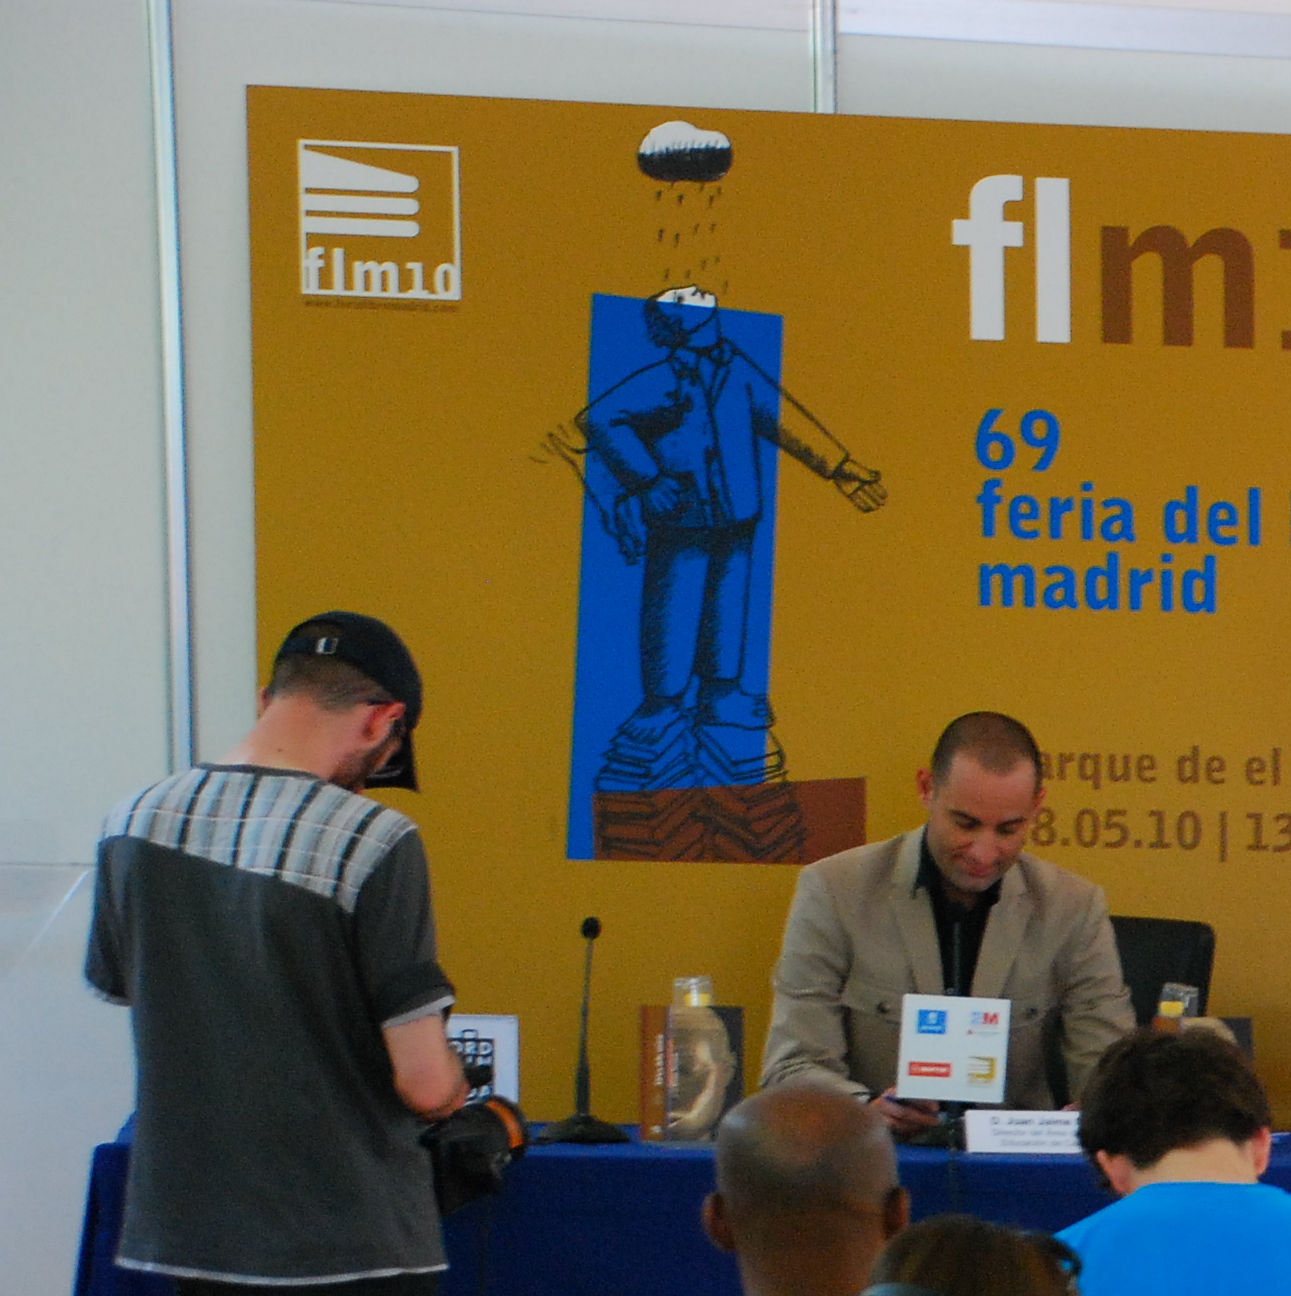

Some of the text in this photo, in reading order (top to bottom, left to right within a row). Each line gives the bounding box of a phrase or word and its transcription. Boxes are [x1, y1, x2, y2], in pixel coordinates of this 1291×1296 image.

[302, 246, 461, 300] flm10
[974, 408, 1061, 473] 69
[976, 478, 1135, 544] feria
[1163, 485, 1261, 547] del
[977, 552, 1217, 614] madrid
[1041, 748, 1157, 790] arque
[1176, 745, 1226, 785] de
[1246, 747, 1281, 786] el
[1024, 807, 1202, 851] 8.05.10
